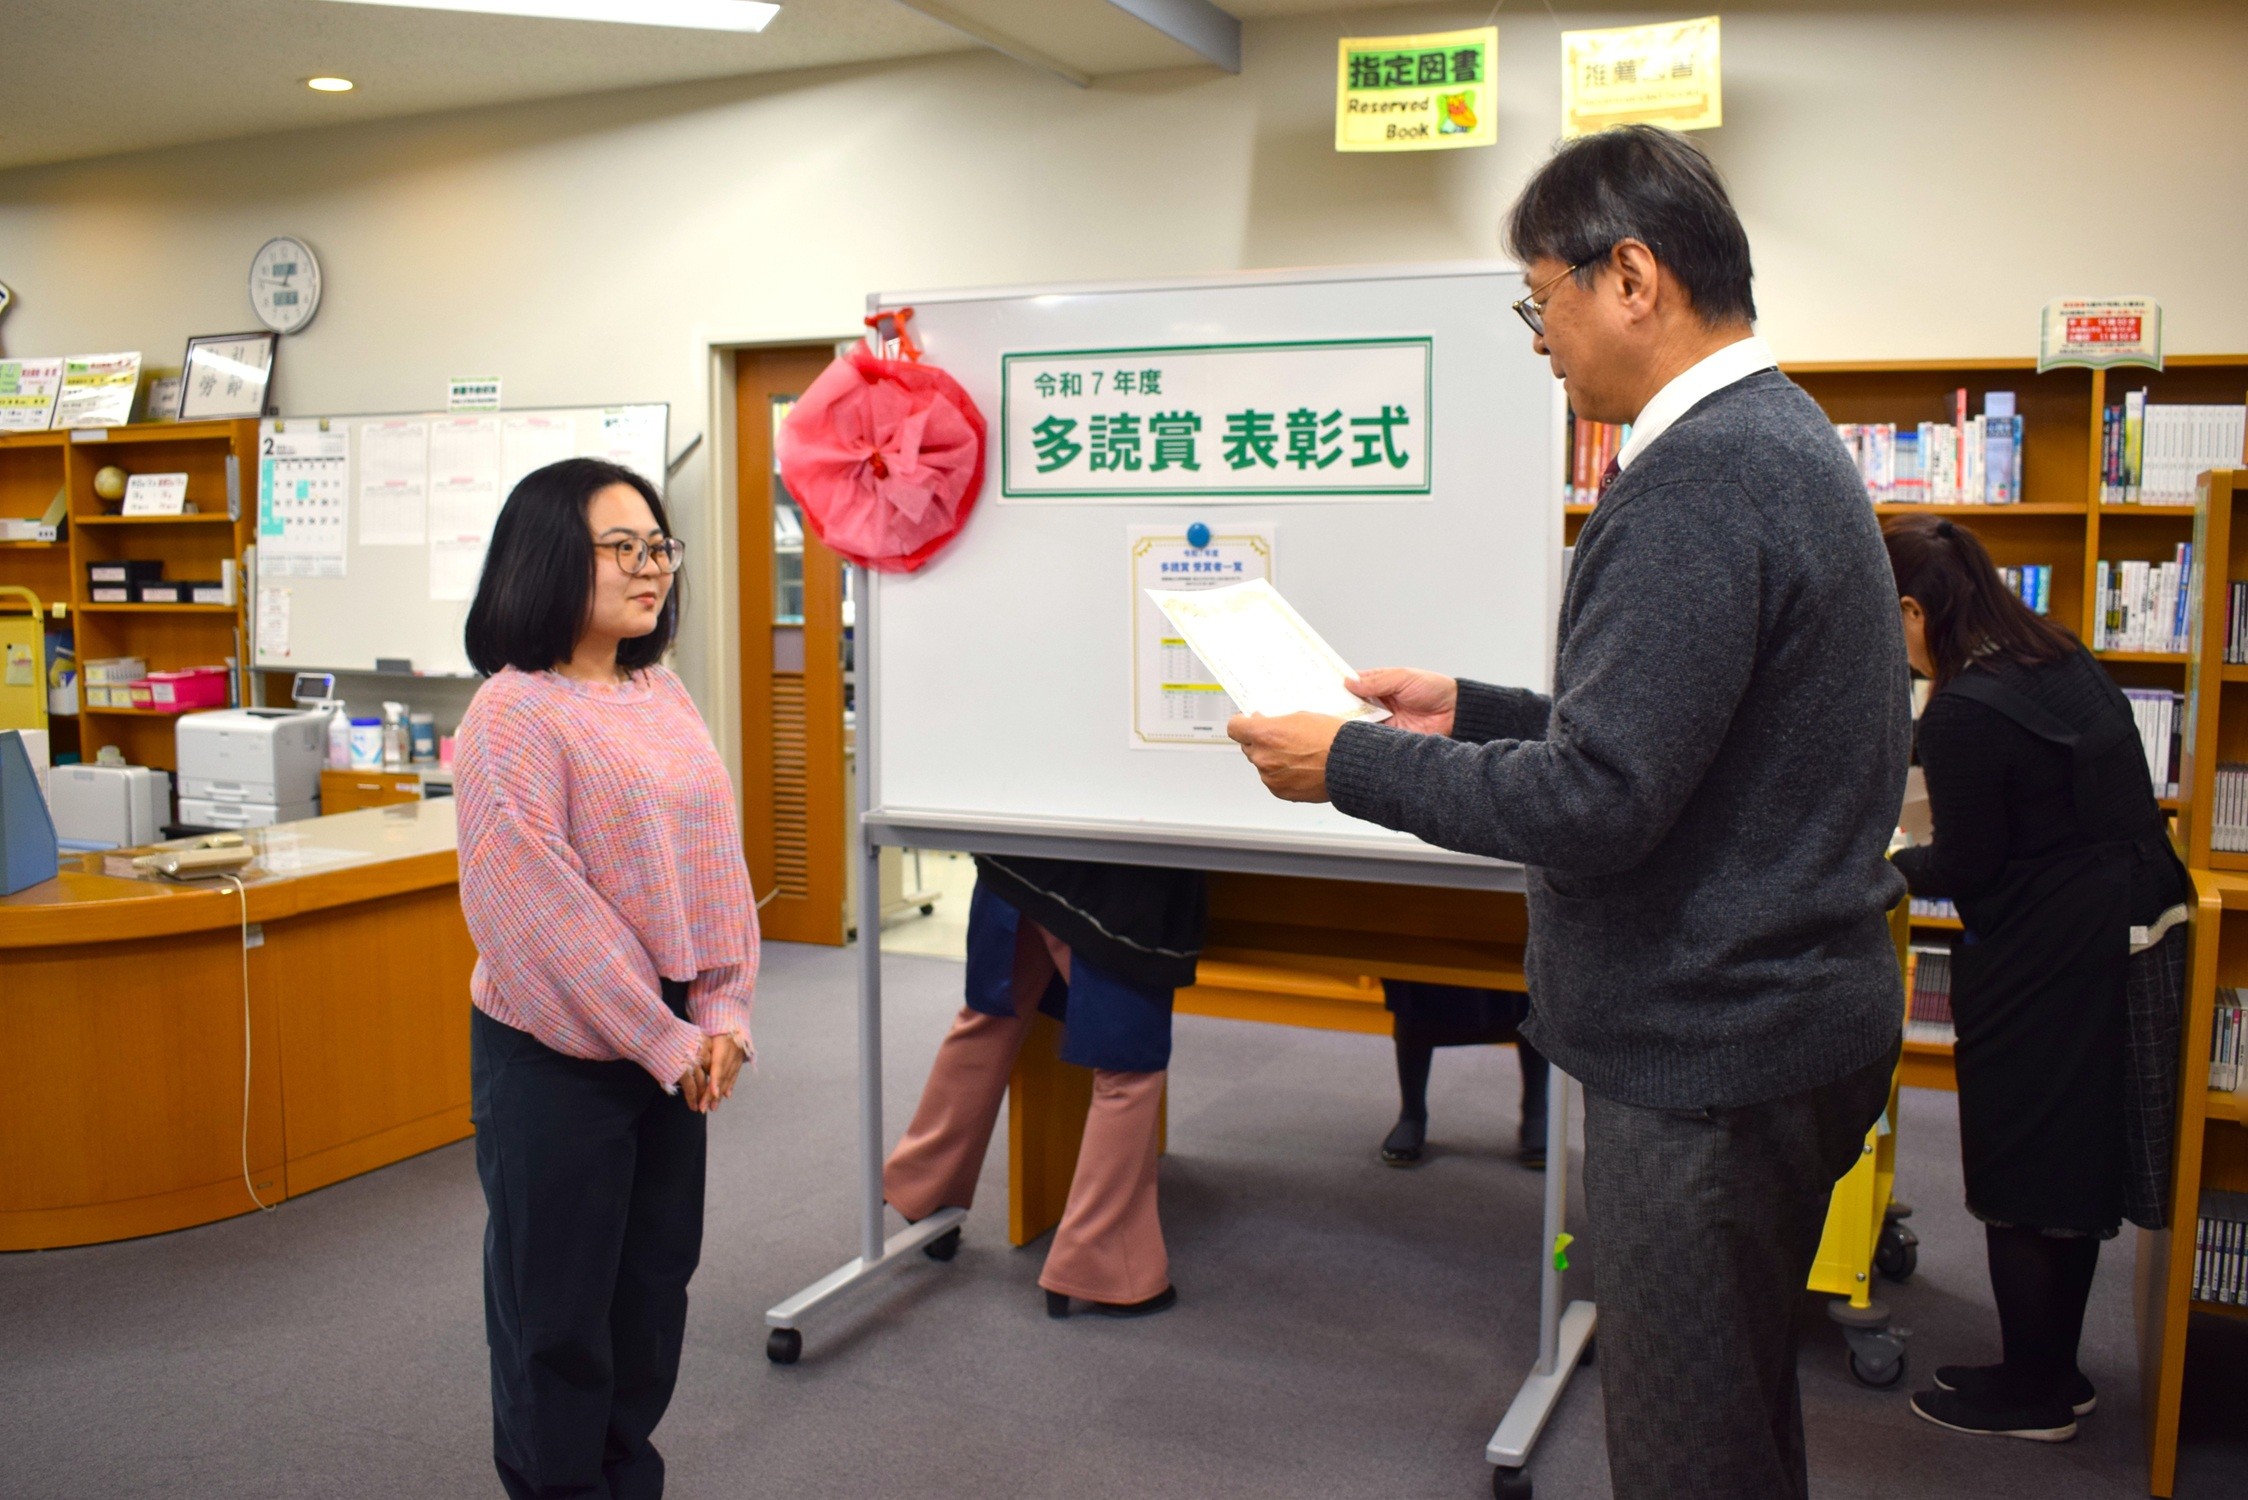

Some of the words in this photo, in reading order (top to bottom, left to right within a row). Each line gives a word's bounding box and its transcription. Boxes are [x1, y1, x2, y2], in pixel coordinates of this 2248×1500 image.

[1349, 48, 1480, 89] 指定図書
[1347, 97, 1430, 114] Reserved
[1386, 122, 1430, 140] Book
[264, 438, 274, 455] 2
[1031, 410, 1203, 474] 多読賞
[1221, 405, 1411, 471] 表彰式
